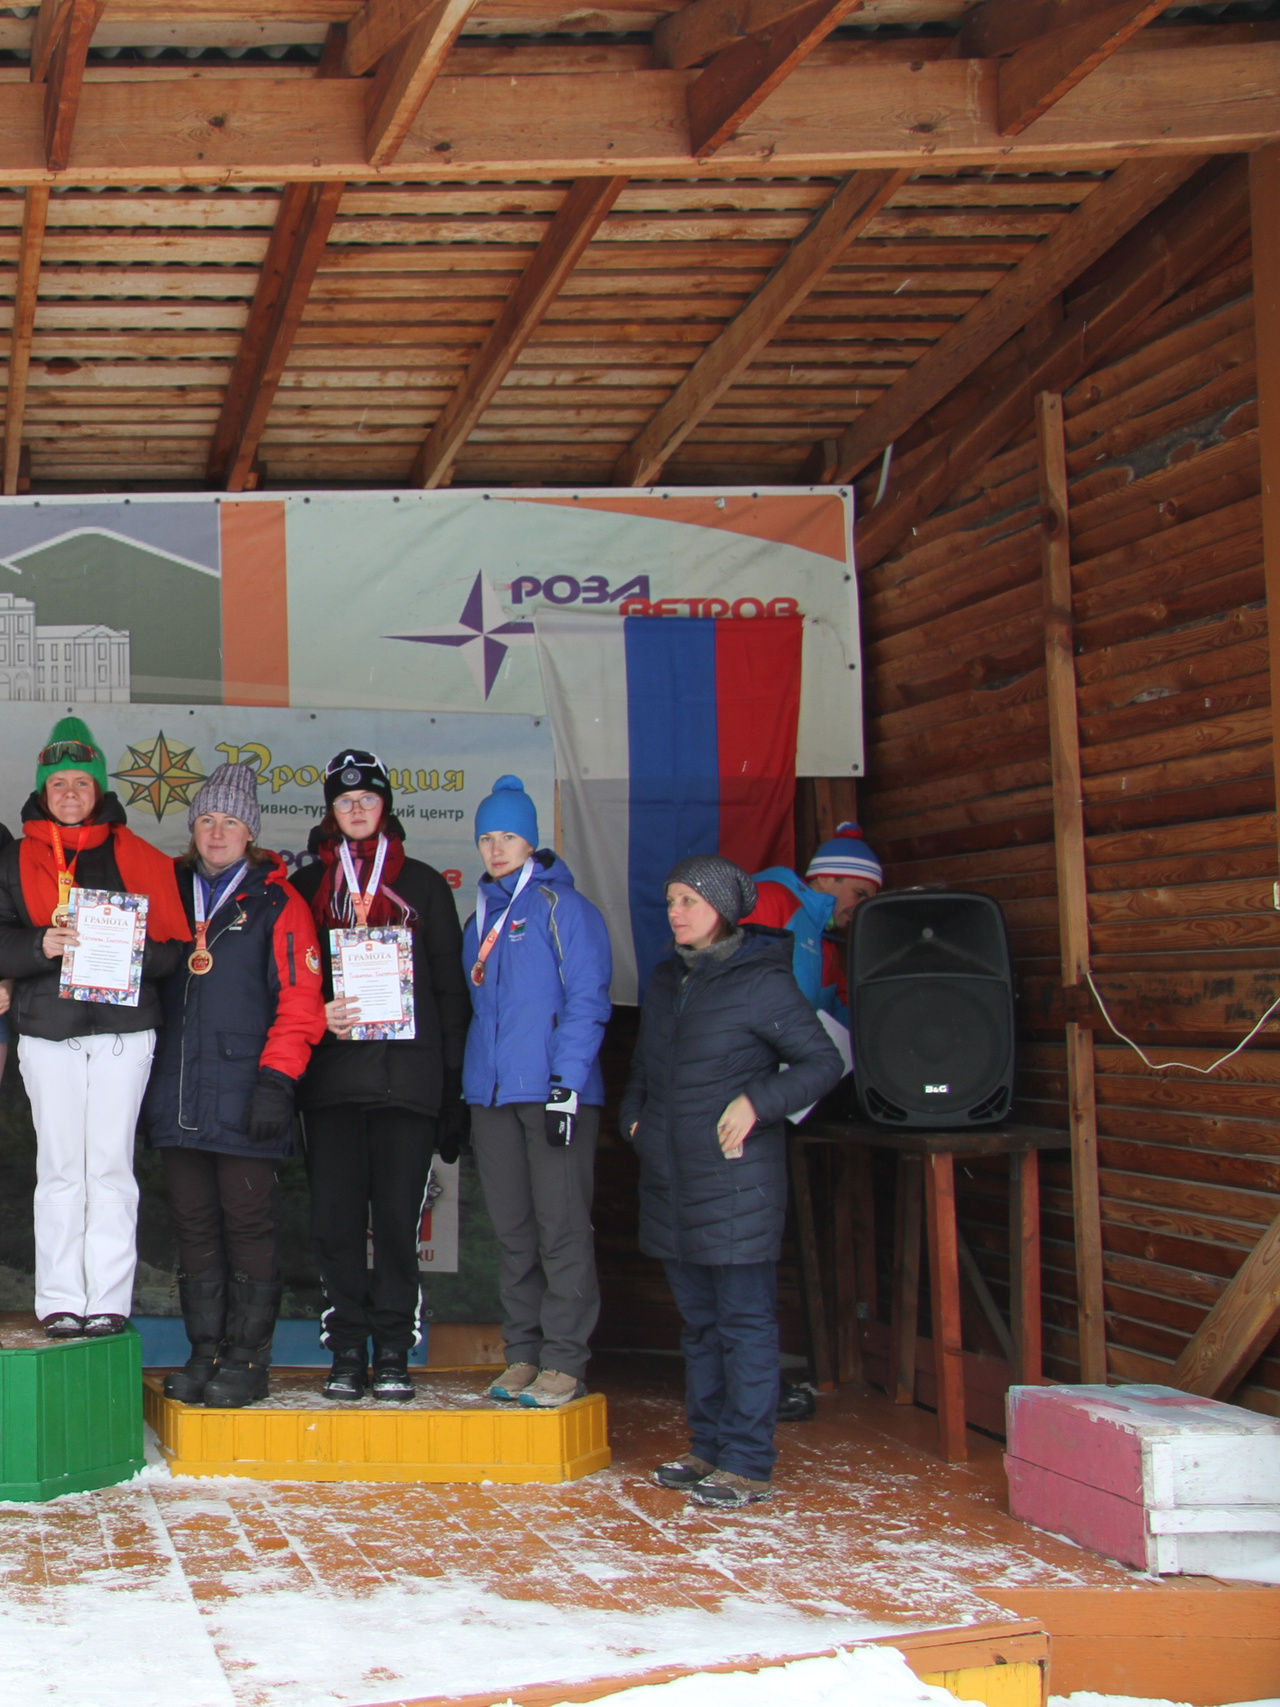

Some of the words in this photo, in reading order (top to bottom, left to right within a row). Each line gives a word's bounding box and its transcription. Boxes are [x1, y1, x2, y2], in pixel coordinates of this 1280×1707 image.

[510, 574, 650, 604] РОЗА
[215, 741, 464, 794] Проция
[420, 806, 464, 822] центр
[84, 915, 129, 927] ГРАМОТА
[348, 952, 392, 962] ГРАМОТА
